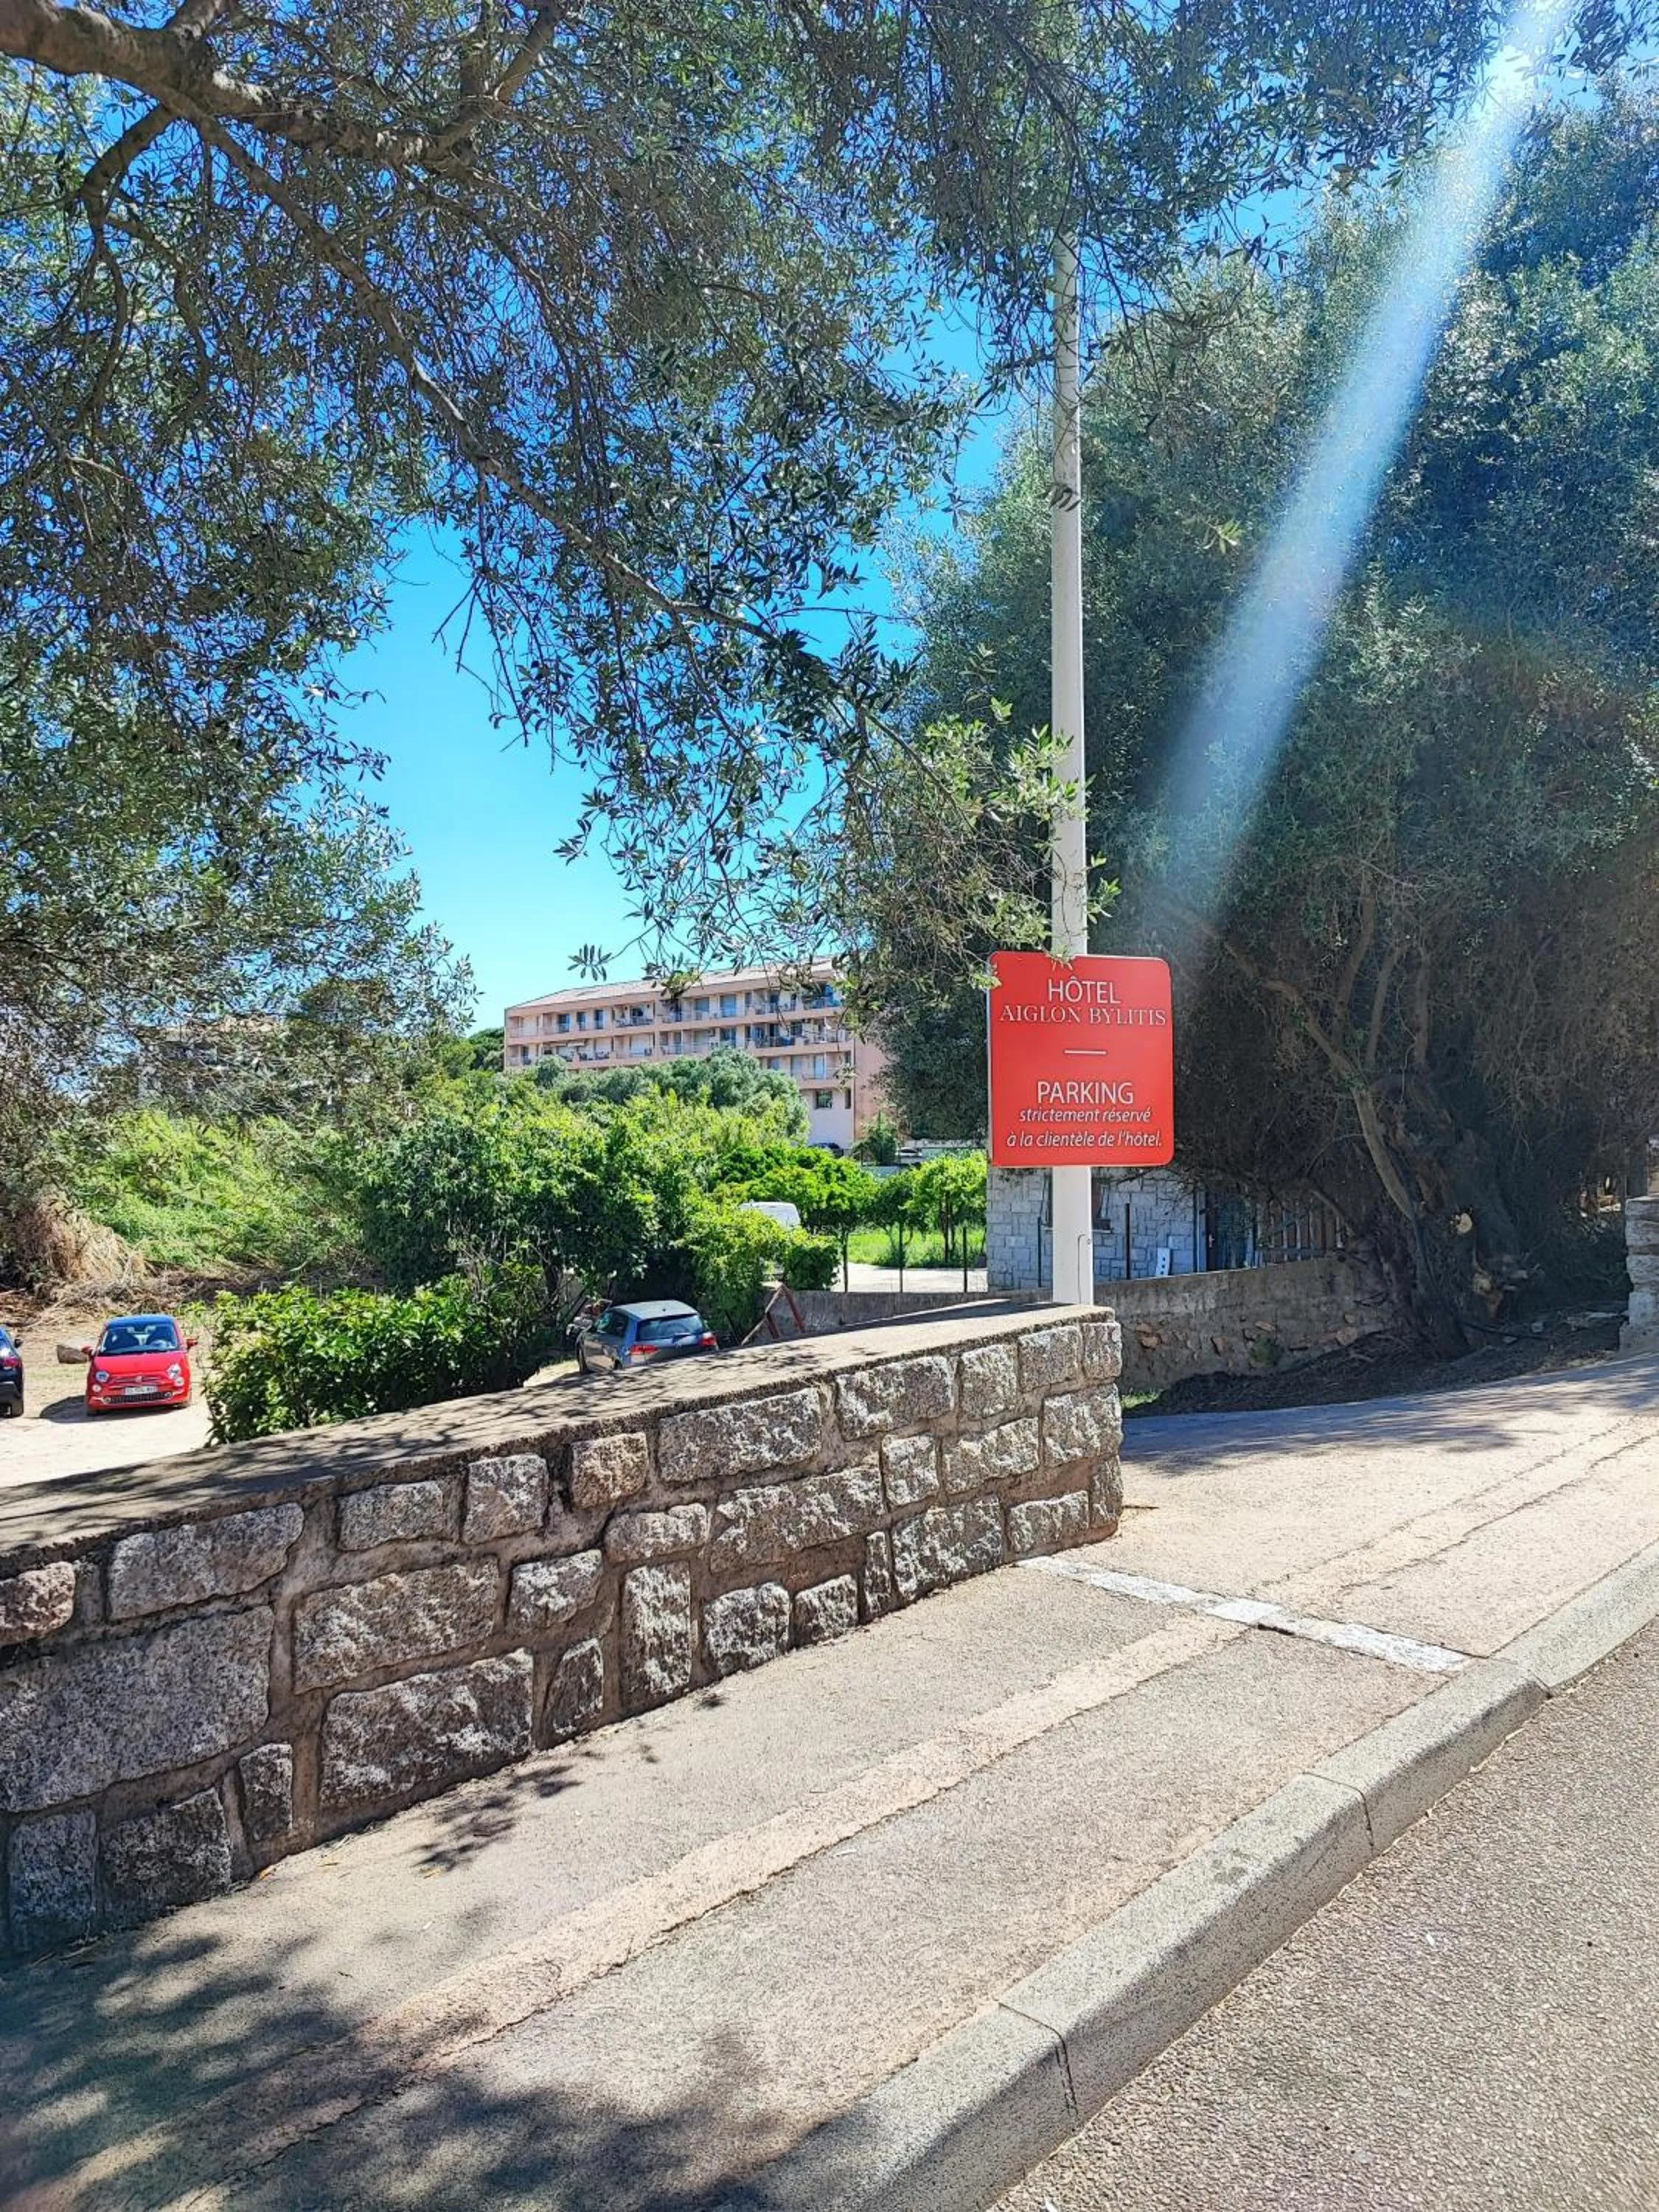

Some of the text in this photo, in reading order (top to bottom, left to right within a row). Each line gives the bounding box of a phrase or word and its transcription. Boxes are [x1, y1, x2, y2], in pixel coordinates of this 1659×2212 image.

[1048, 975, 1121, 1004] HÔTEL
[999, 1005, 1166, 1026] AIGLON BYLITIS
[1037, 1081, 1134, 1105] PARKING
[1019, 1107, 1152, 1122] strictement réservé
[1006, 1131, 1018, 1147] à
[1020, 1130, 1033, 1147] la
[1036, 1130, 1095, 1147] clientèle
[1098, 1131, 1116, 1147] de
